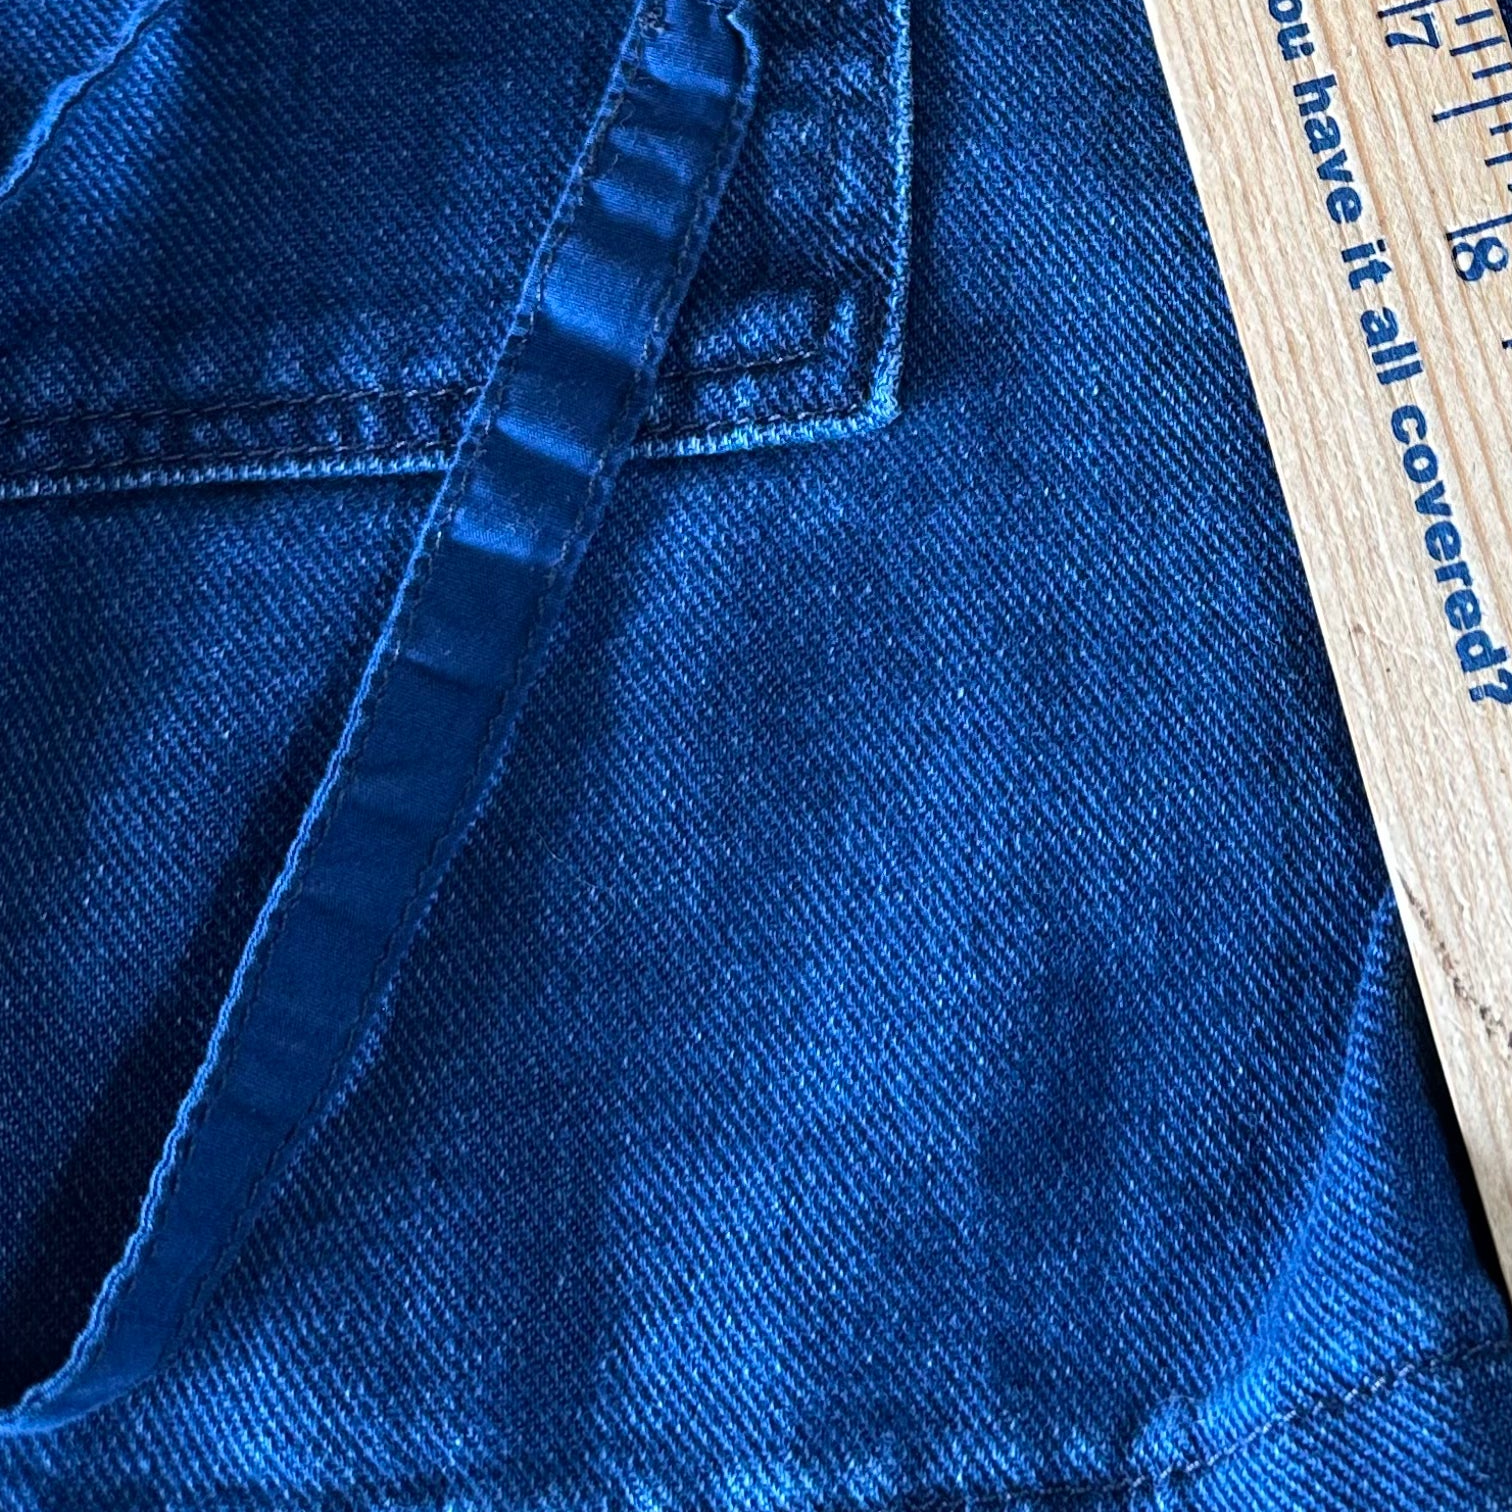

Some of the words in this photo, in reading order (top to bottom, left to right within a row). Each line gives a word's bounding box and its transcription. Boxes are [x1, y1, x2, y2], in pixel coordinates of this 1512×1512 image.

[1293, 74, 1363, 224] have
[1385, 11, 1442, 50] 7
[1452, 236, 1509, 282] 8
[1341, 239, 1393, 290] it
[1360, 306, 1424, 386] all
